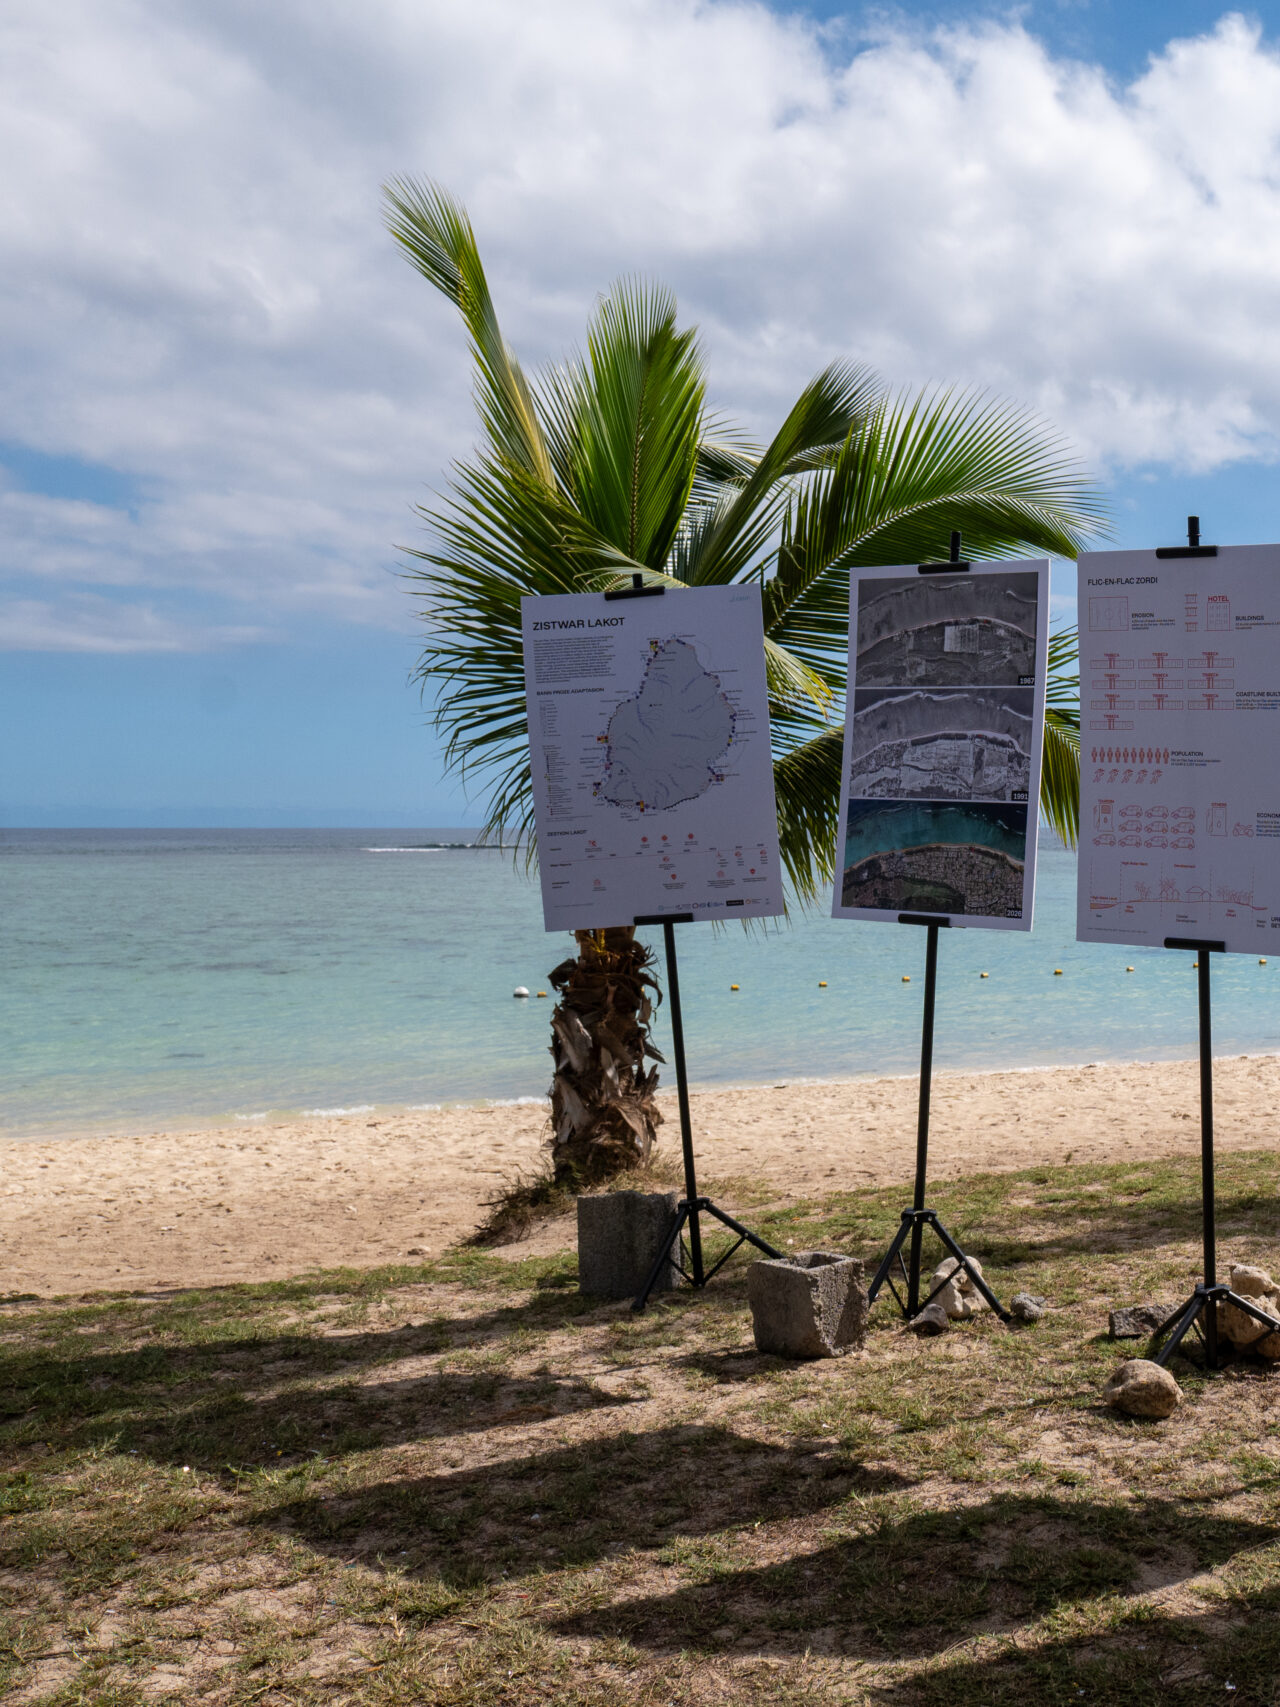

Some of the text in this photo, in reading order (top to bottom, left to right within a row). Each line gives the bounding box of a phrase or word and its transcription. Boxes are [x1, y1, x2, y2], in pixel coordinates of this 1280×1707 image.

[1087, 576, 1158, 586] FLIC-EN-FLAC ZORDI
[532, 617, 625, 631] ZISTWAR LAKOT
